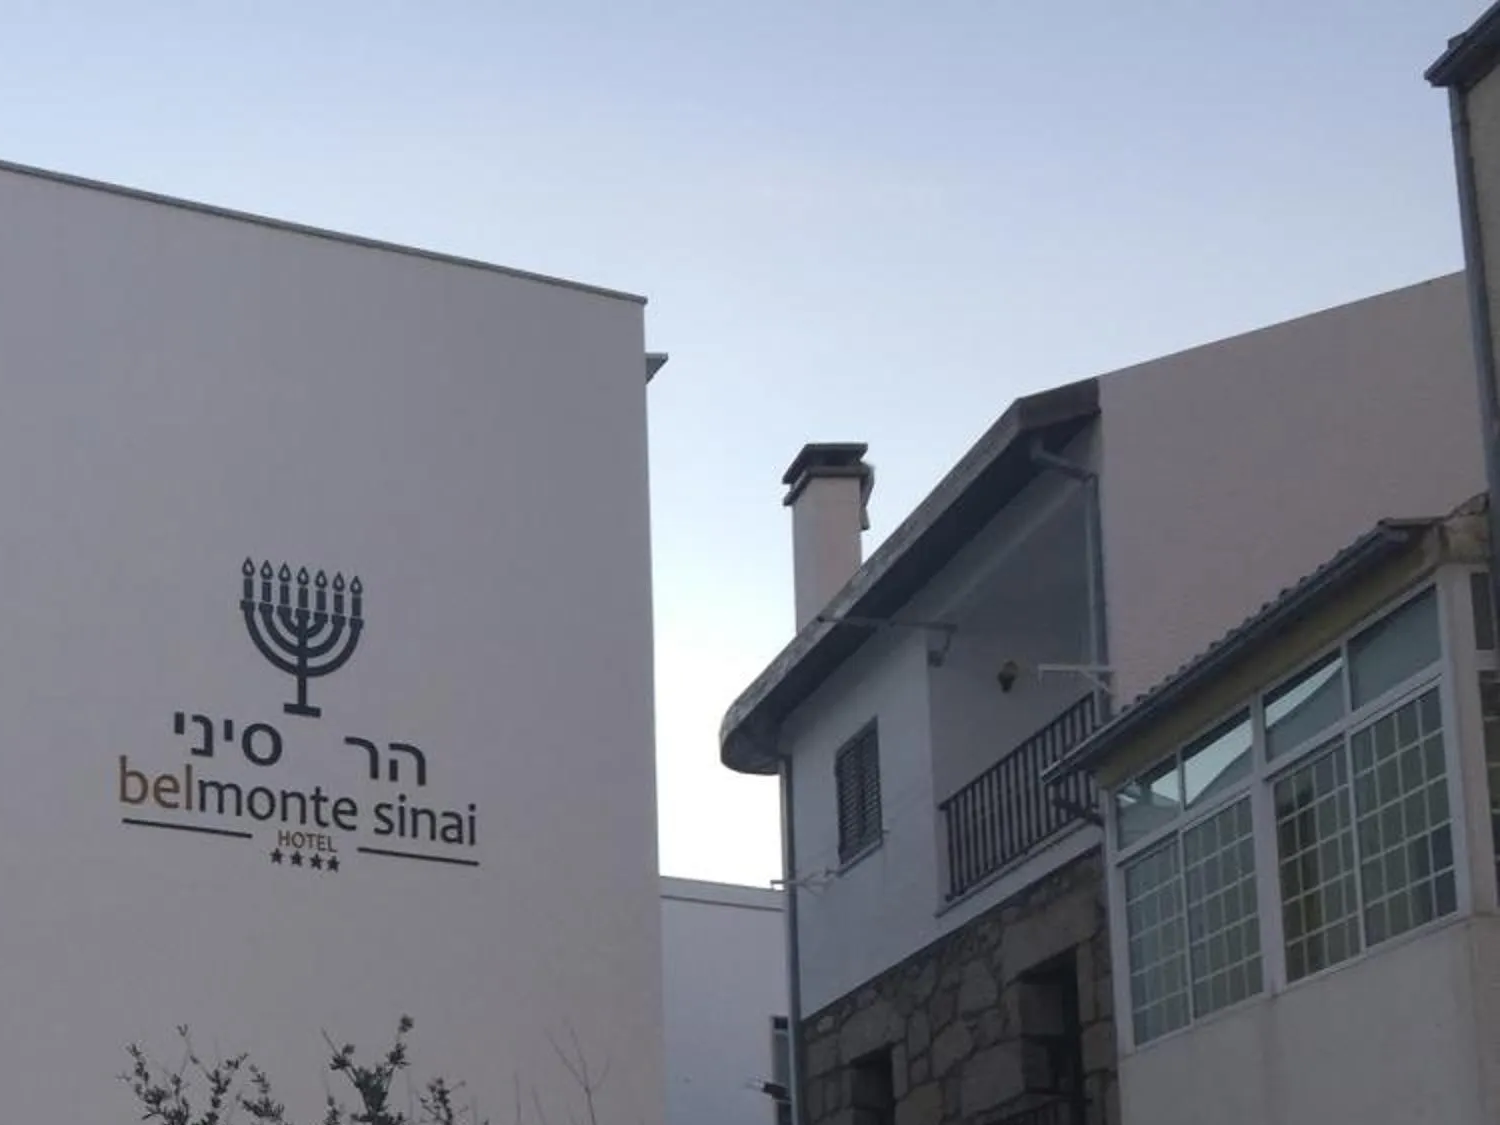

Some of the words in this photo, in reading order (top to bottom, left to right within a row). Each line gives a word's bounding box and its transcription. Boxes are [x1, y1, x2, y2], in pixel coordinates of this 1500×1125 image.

[173, 711, 284, 767] סיני
[343, 736, 428, 787] הר
[118, 754, 359, 832] belmonte
[373, 793, 479, 847] sinai
[277, 829, 339, 853] HOTEL
